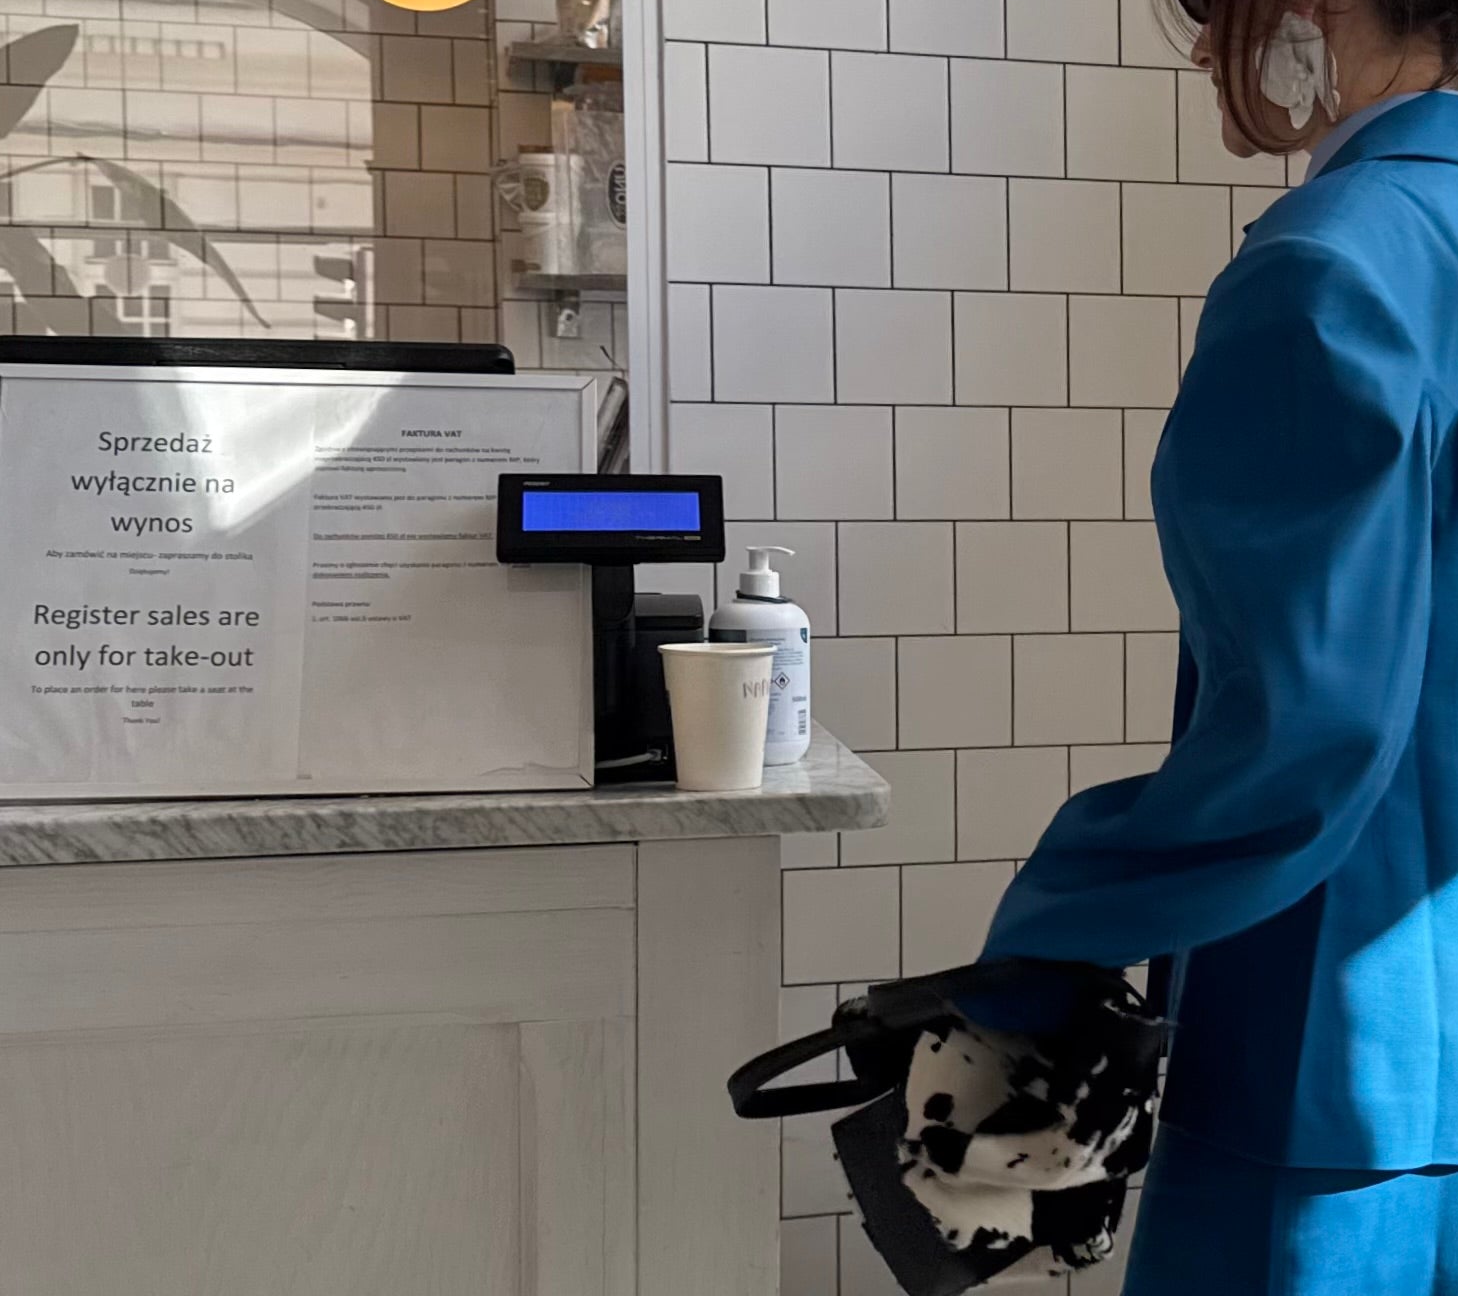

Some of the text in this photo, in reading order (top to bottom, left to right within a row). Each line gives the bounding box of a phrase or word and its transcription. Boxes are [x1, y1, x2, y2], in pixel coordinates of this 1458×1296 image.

[98, 431, 213, 456] Sprzedaż
[401, 430, 462, 438] FAKTURA VAT
[71, 470, 235, 496] wyłącznie na
[110, 516, 194, 537] wynos
[46, 549, 63, 559] Aby
[65, 549, 104, 559] zamówić
[158, 553, 209, 562] zapraszamy
[211, 552, 223, 560] do
[224, 552, 253, 561] stolika
[33, 604, 260, 630] Register sales are
[35, 644, 255, 671] only for take-out
[31, 685, 42, 694] To
[43, 685, 68, 696] place
[83, 685, 108, 694] order
[110, 685, 123, 694] for
[125, 685, 146, 694] here
[148, 685, 177, 696] please
[178, 685, 197, 694] take
[207, 686, 226, 694] seat
[226, 686, 238, 694] at
[238, 685, 254, 694] the
[131, 699, 154, 709] table
